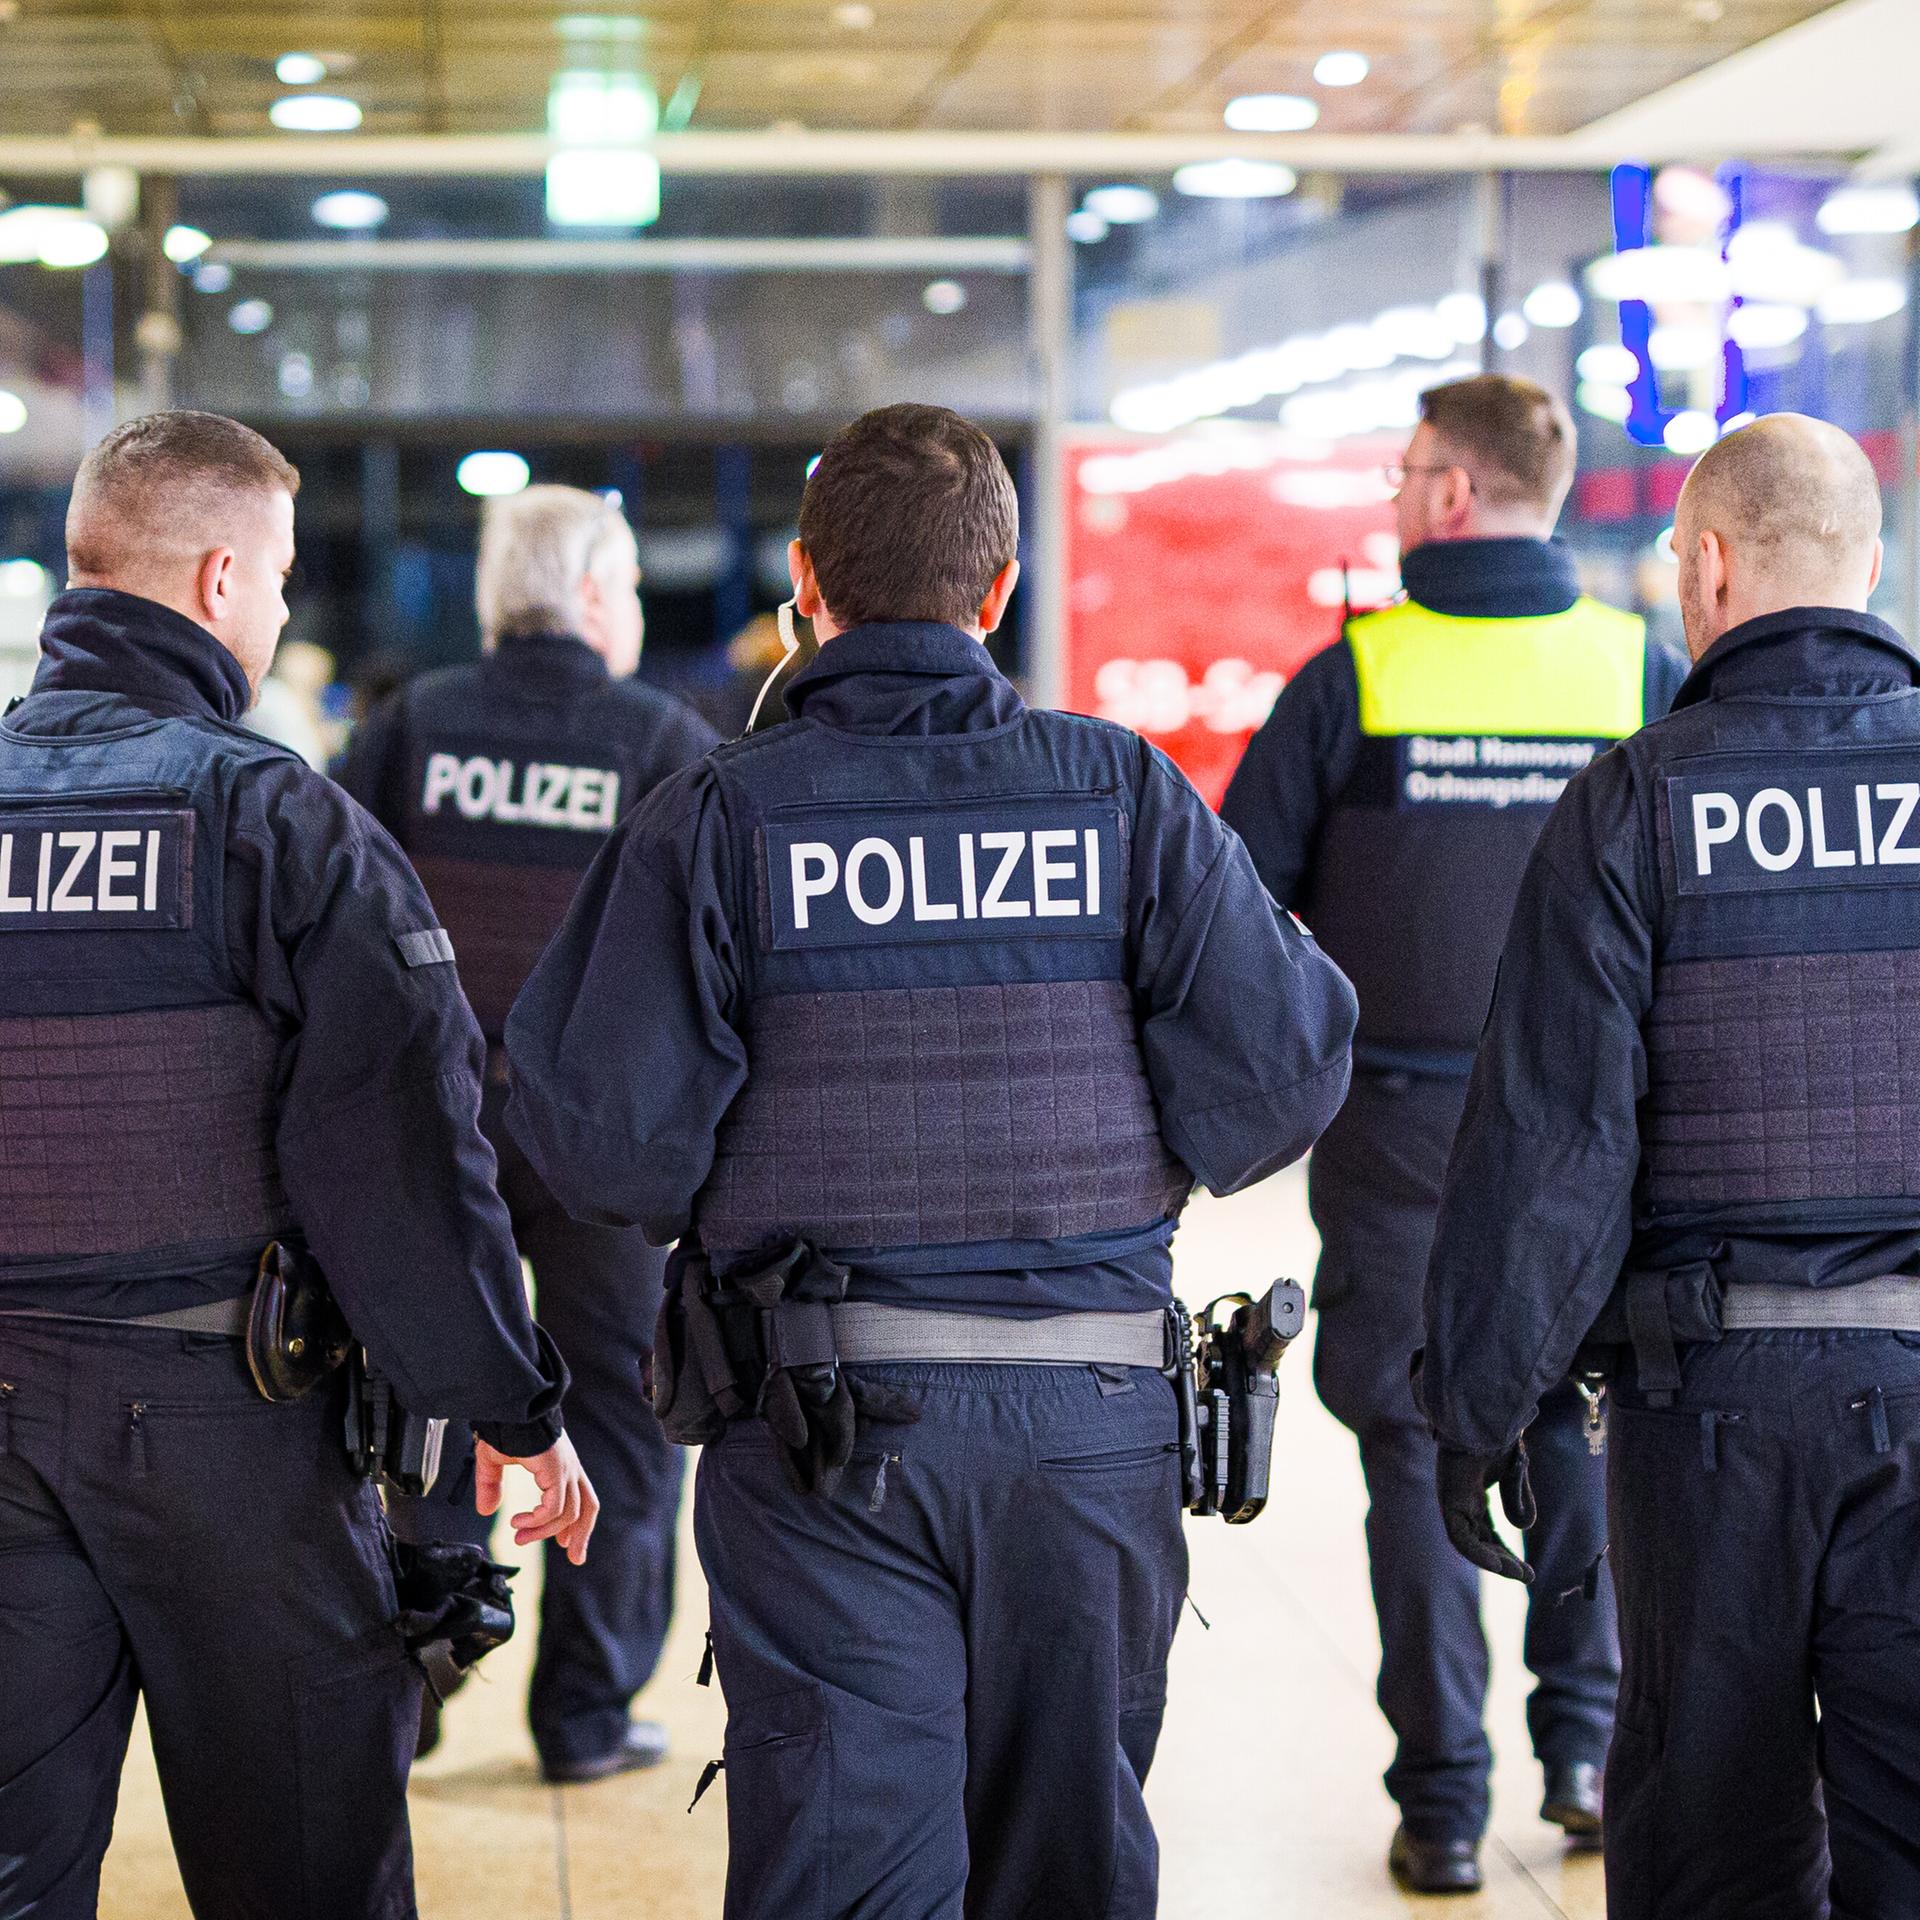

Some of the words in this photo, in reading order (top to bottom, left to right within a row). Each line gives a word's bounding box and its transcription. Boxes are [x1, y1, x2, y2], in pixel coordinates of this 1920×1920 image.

[423, 752, 620, 832] POLIZEI
[1408, 737, 1477, 767] Stadt
[1479, 737, 1595, 768] Hannover
[0, 829, 161, 913] LIZEI
[1692, 782, 1920, 876] POLIZ
[789, 828, 1100, 929] POLIZEI
